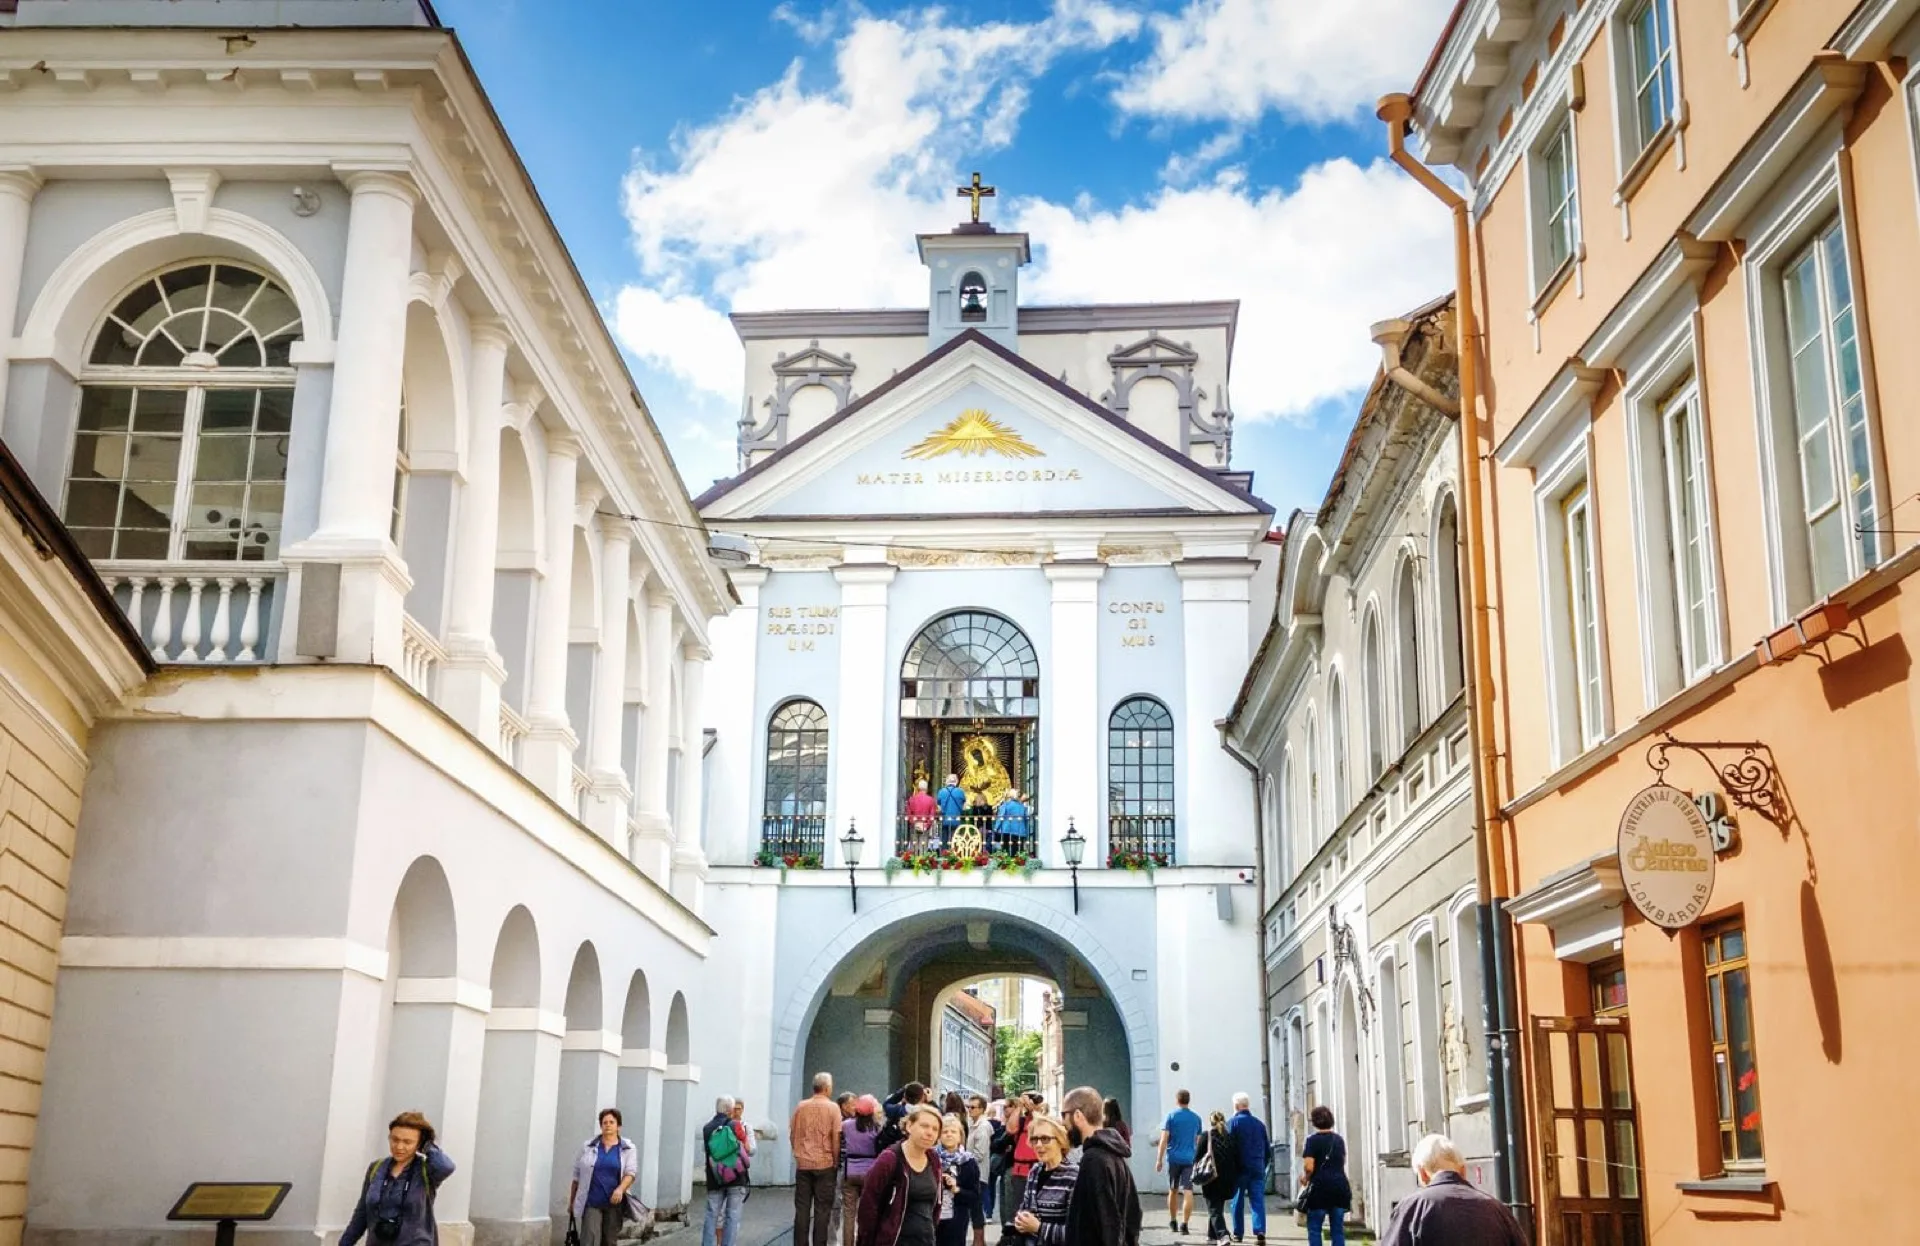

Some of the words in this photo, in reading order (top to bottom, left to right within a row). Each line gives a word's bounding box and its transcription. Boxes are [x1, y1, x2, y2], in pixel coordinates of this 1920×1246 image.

[857, 472, 923, 485] MATER
[1109, 601, 1165, 614] CONFU
[1121, 635, 1156, 647] MUS
[1630, 883, 1708, 924] LOMBARDAS
